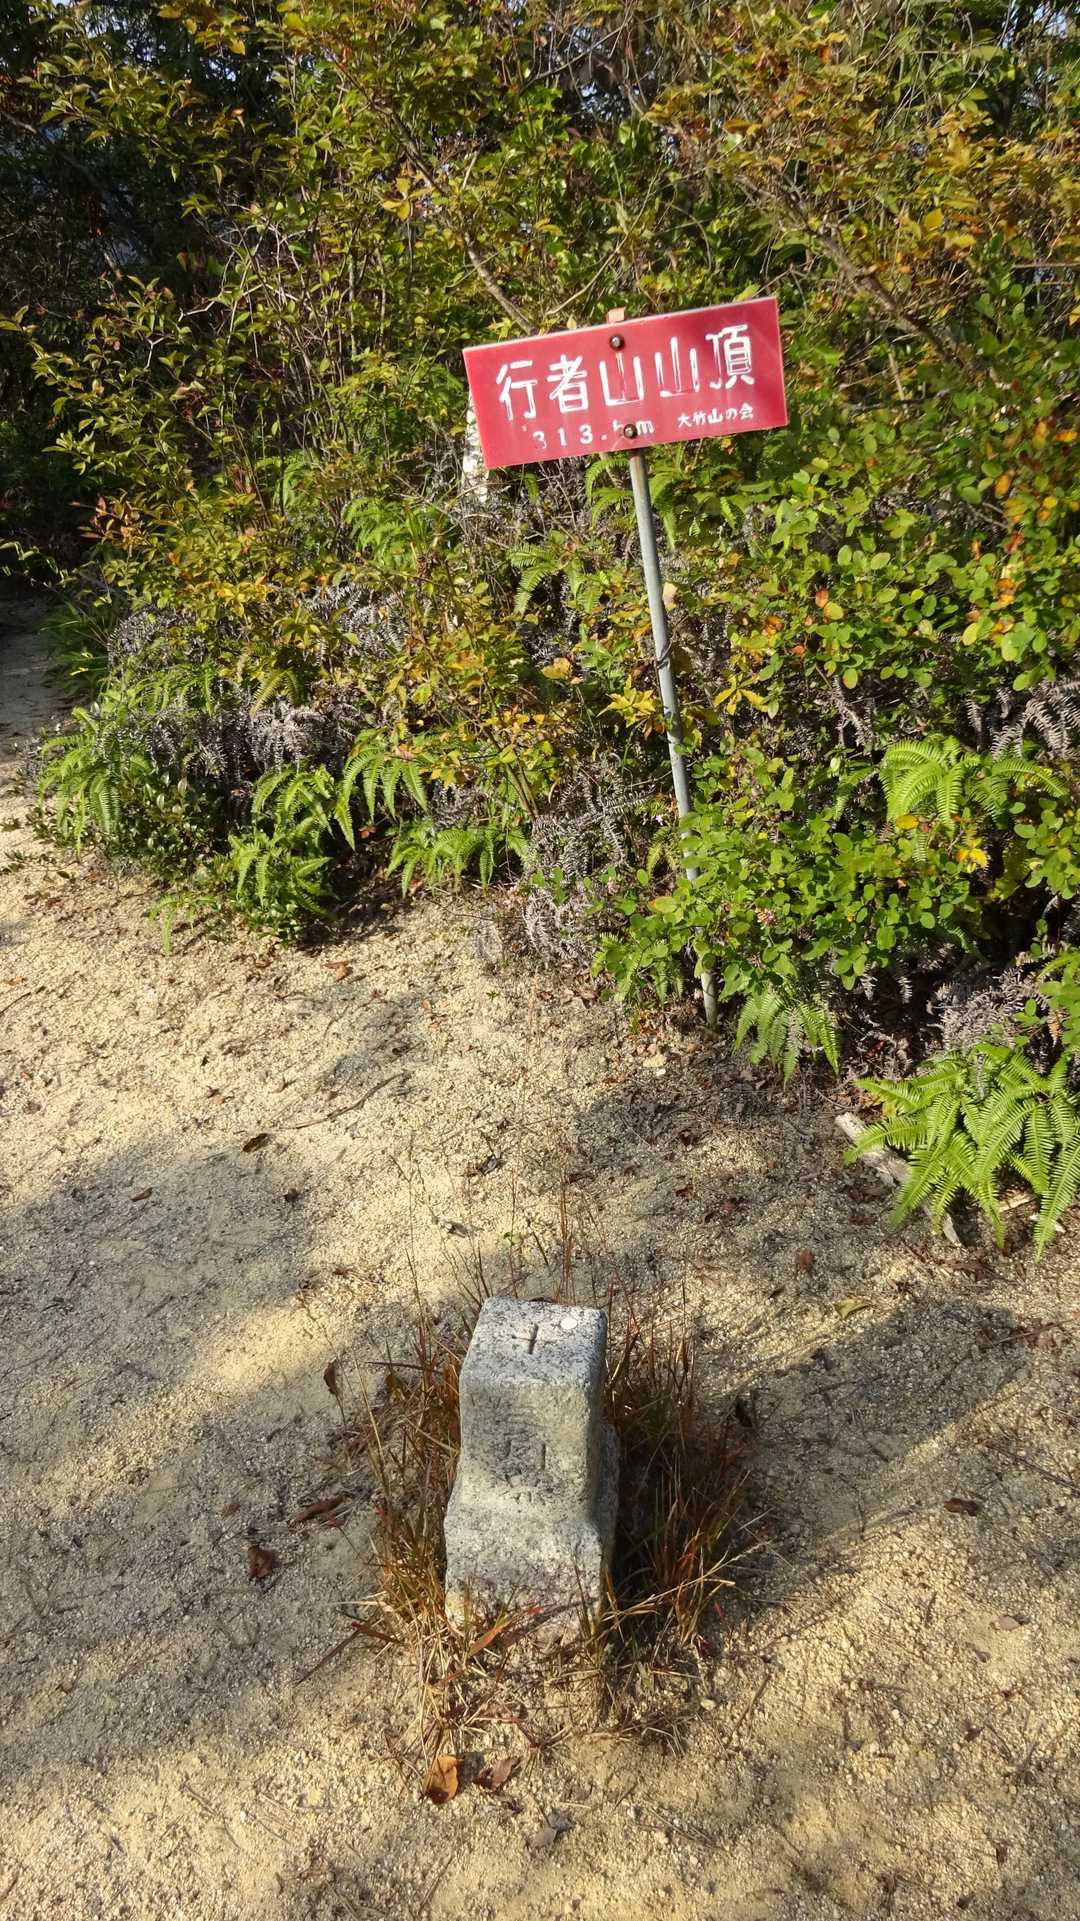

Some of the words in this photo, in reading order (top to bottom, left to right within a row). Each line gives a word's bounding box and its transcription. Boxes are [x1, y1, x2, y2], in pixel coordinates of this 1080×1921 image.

[495, 323, 755, 421] 行者山山頂
[677, 402, 754, 428] 大竹山の会
